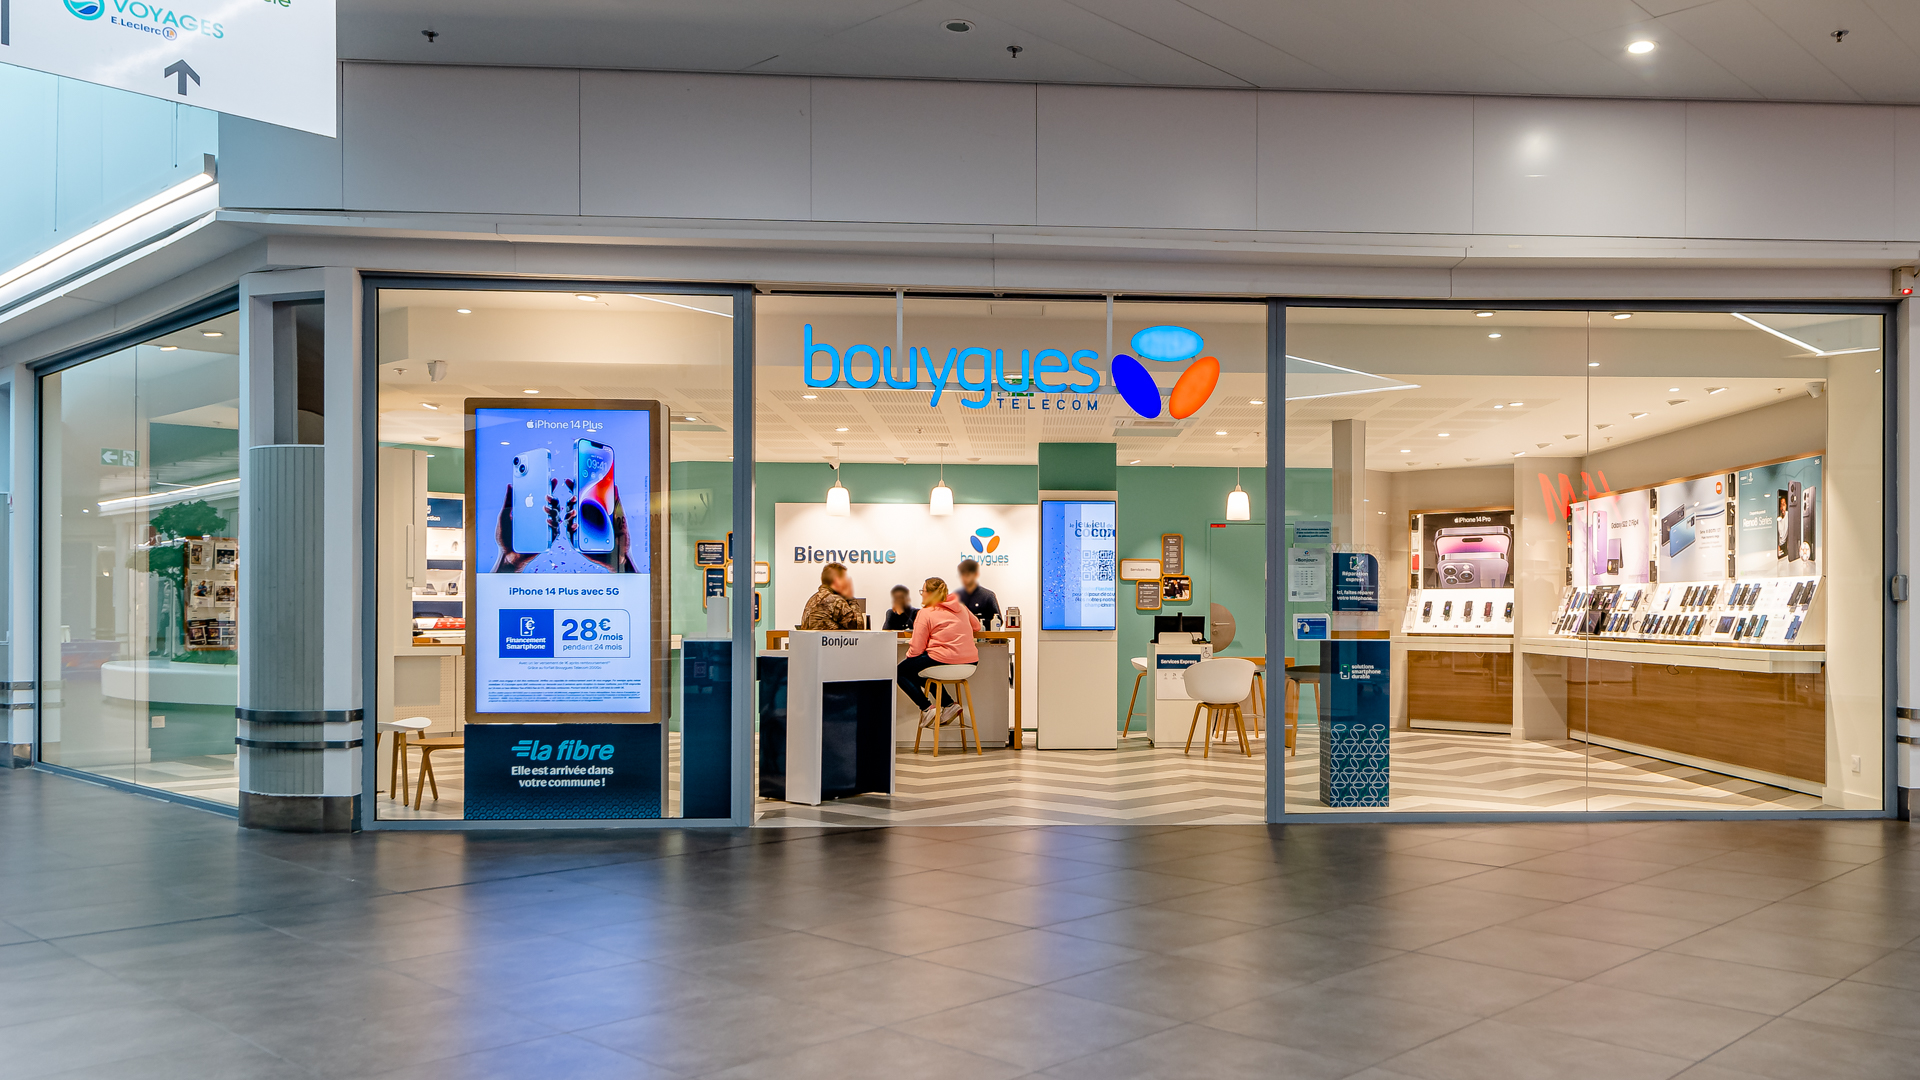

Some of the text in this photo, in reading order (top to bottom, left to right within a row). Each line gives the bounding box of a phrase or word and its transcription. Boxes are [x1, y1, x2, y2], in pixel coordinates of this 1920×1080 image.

[113, 0, 224, 39] VOYAGES
[111, 16, 161, 36] E.Leclerc
[804, 324, 1100, 409] bouygues
[997, 398, 1098, 411] TELECOM
[535, 420, 603, 430] iPhone 14 Plus
[794, 546, 896, 564] Bienvenue
[509, 587, 543, 595] iPhone
[545, 587, 556, 595] 14
[558, 587, 579, 596] Plus
[606, 587, 619, 596] 5G
[599, 632, 623, 641] /mois
[821, 635, 859, 647] Bonjour
[506, 643, 546, 651] Smartphone
[563, 643, 593, 651] pendant
[530, 739, 614, 761] la fibre
[511, 766, 614, 775] Elle est arrivée dans
[519, 779, 547, 787] votre
[548, 779, 600, 787] commune
